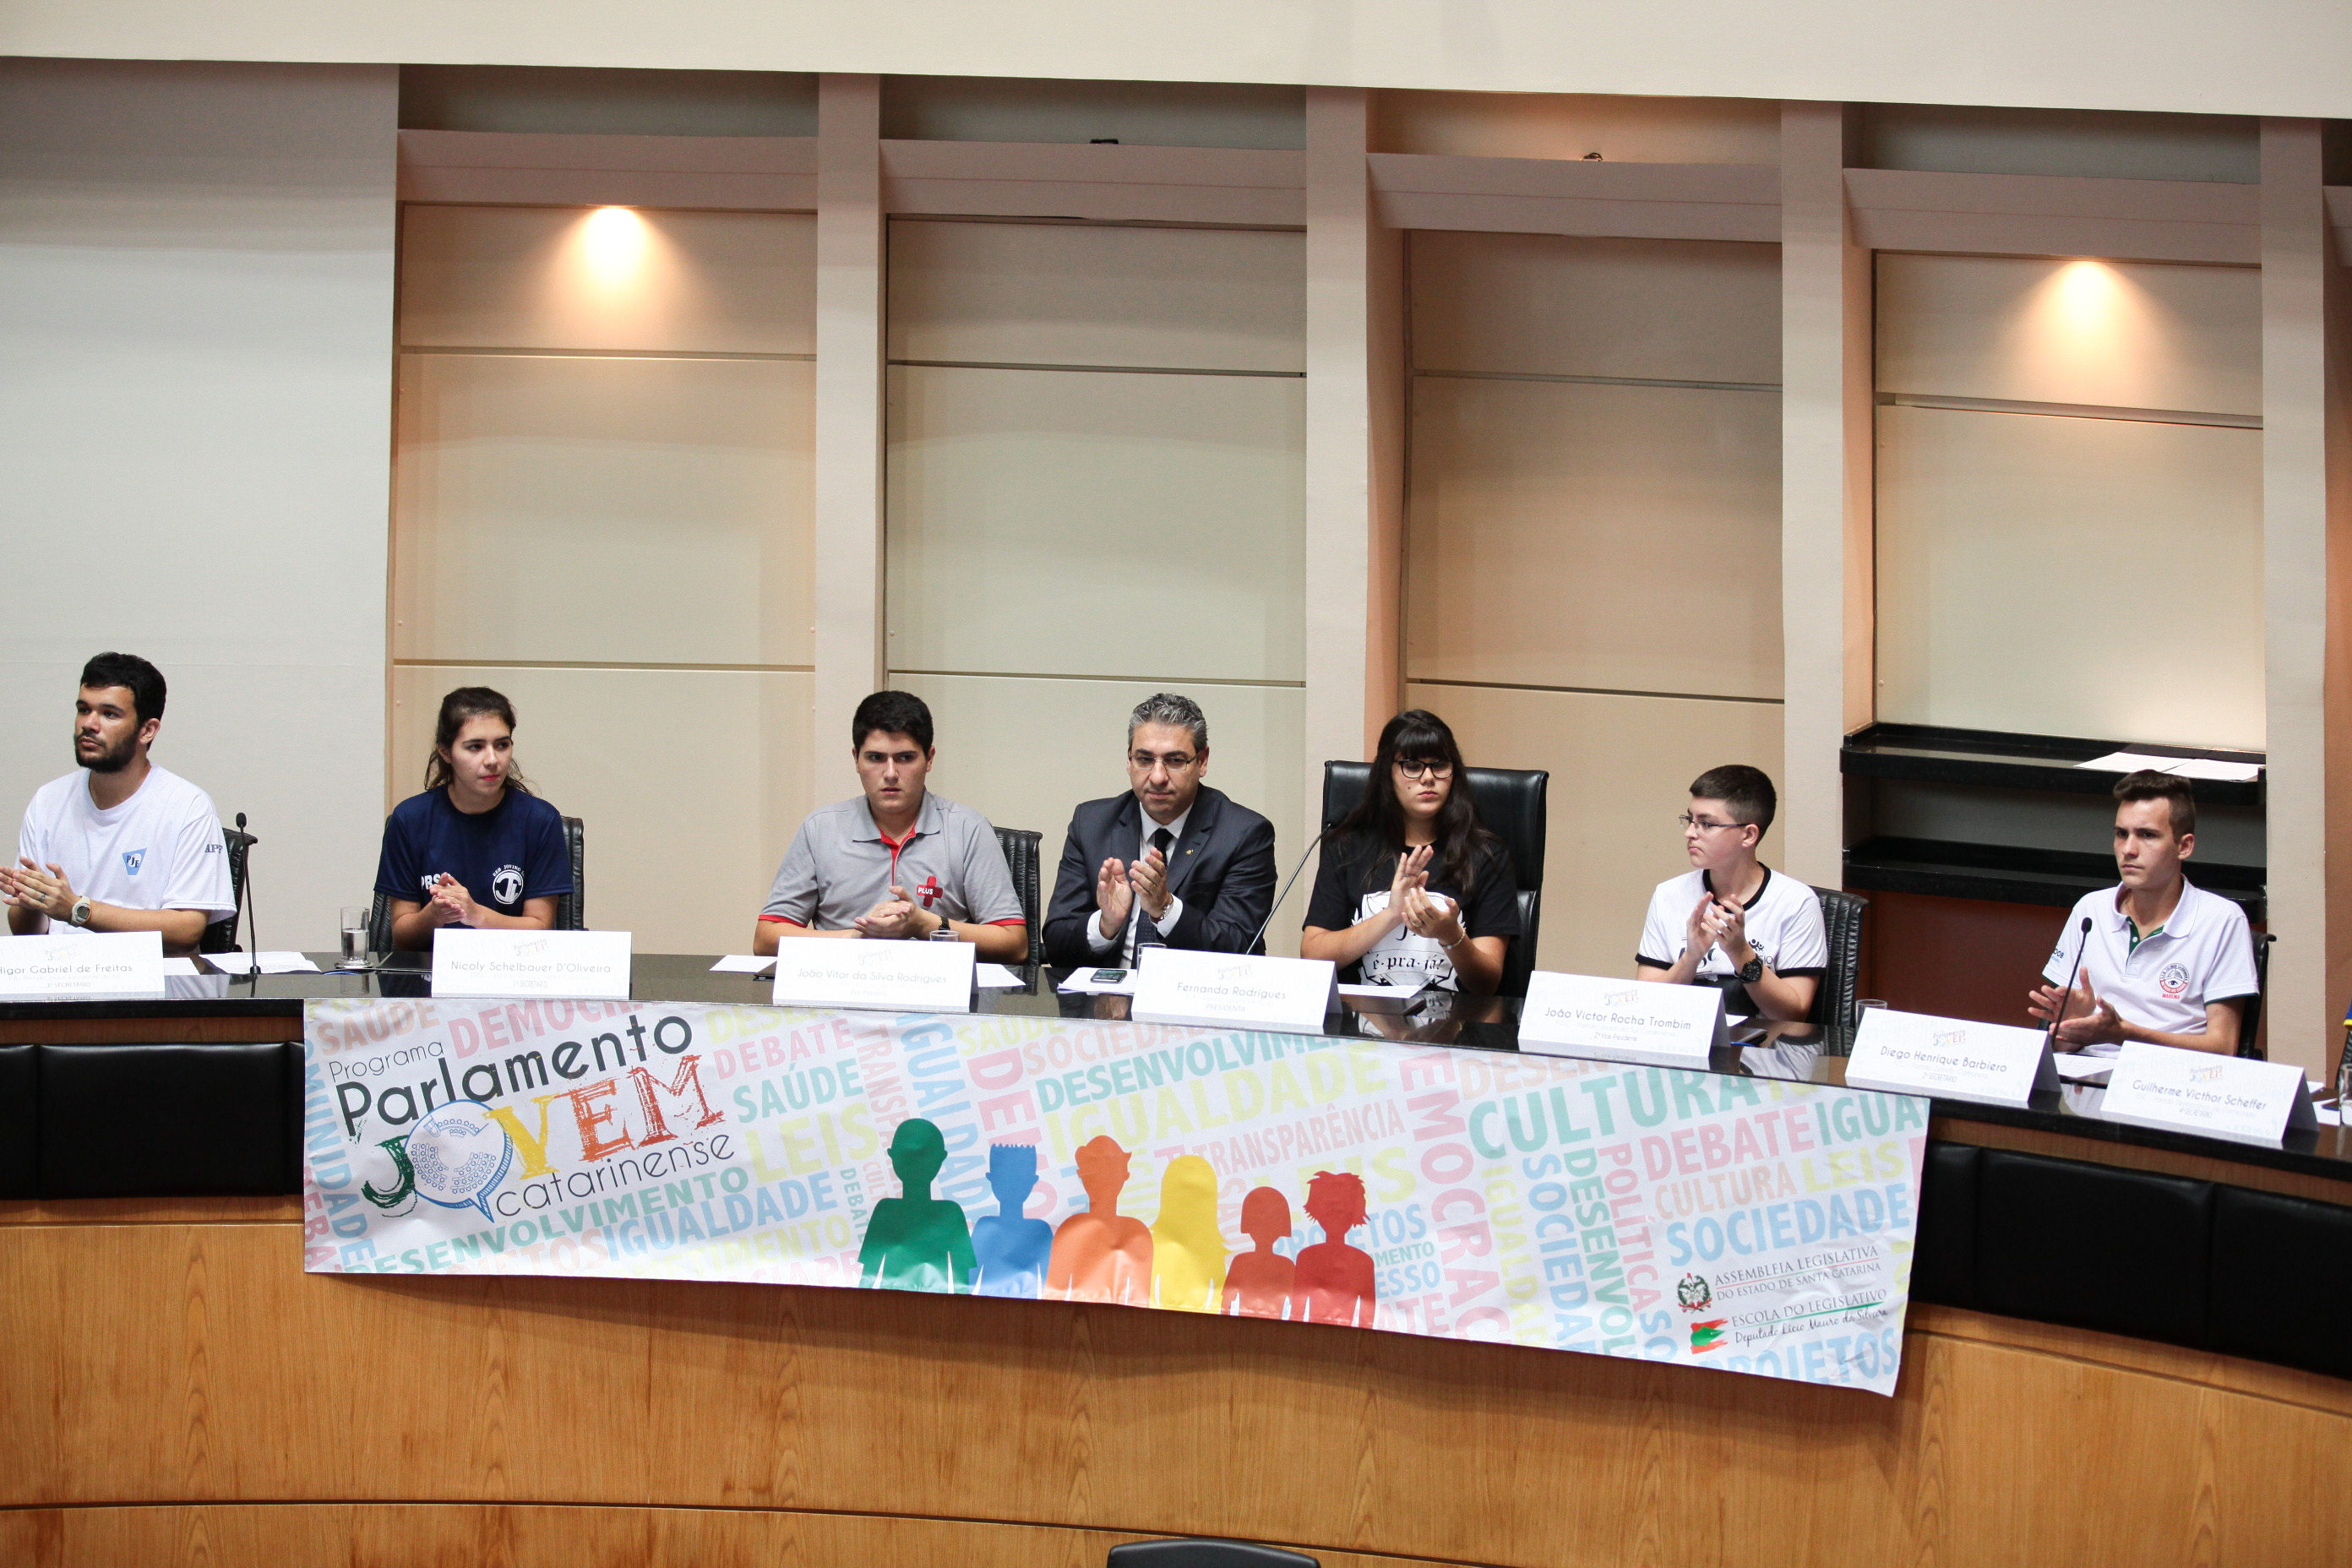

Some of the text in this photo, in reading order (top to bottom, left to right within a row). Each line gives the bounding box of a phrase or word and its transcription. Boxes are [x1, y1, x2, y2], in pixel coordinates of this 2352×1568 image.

[917, 886, 934, 896] PLUS
[30, 965, 72, 974] Gabriel
[76, 965, 91, 973] de
[95, 964, 133, 973] Freitas
[451, 961, 611, 973] Nicoly Schelbauer D'Oliveira
[798, 968, 947, 984] João Vitor da Silva Rodrigues
[1177, 982, 1287, 1000] Fernanda Rodrigues
[1206, 1003, 1245, 1013] PRESIDENTA
[1545, 1007, 1691, 1030] João Victor Rocha Trombim
[329, 1040, 445, 1082] Programa
[712, 1017, 854, 1081] DEBATE
[1880, 1045, 2007, 1073] Diego Henrique Barbiero
[335, 1015, 693, 1138] Parlamento
[732, 1057, 865, 1124] SAÚDE
[2132, 1079, 2268, 1111] Guilherme Victhor Scheffer
[1045, 1041, 1386, 1164] IGUALDADE
[1468, 1067, 1761, 1159] CULTURA
[743, 1102, 879, 1183] LEIS
[1640, 1105, 1815, 1182] DEBATE
[496, 1133, 735, 1217] catarinense
[1799, 1141, 1905, 1194] LEIS
[1654, 1161, 1798, 1220] CULTURA
[602, 1170, 839, 1262] IGUALDADE
[1598, 1142, 1663, 1312] POLÍTICA
[1665, 1182, 1910, 1267] SOCIEDADE
[1714, 1244, 1880, 1286] ASSEMBLEIA LEGISLATIVA
[1717, 1262, 1881, 1300] DO ESTADO DE SANTA CATARINA
[1731, 1288, 1887, 1328] ESCOLA DO LEGISLATIVO
[1735, 1325, 1778, 1348] Deputado
[1808, 1317, 1839, 1331] Mauro
